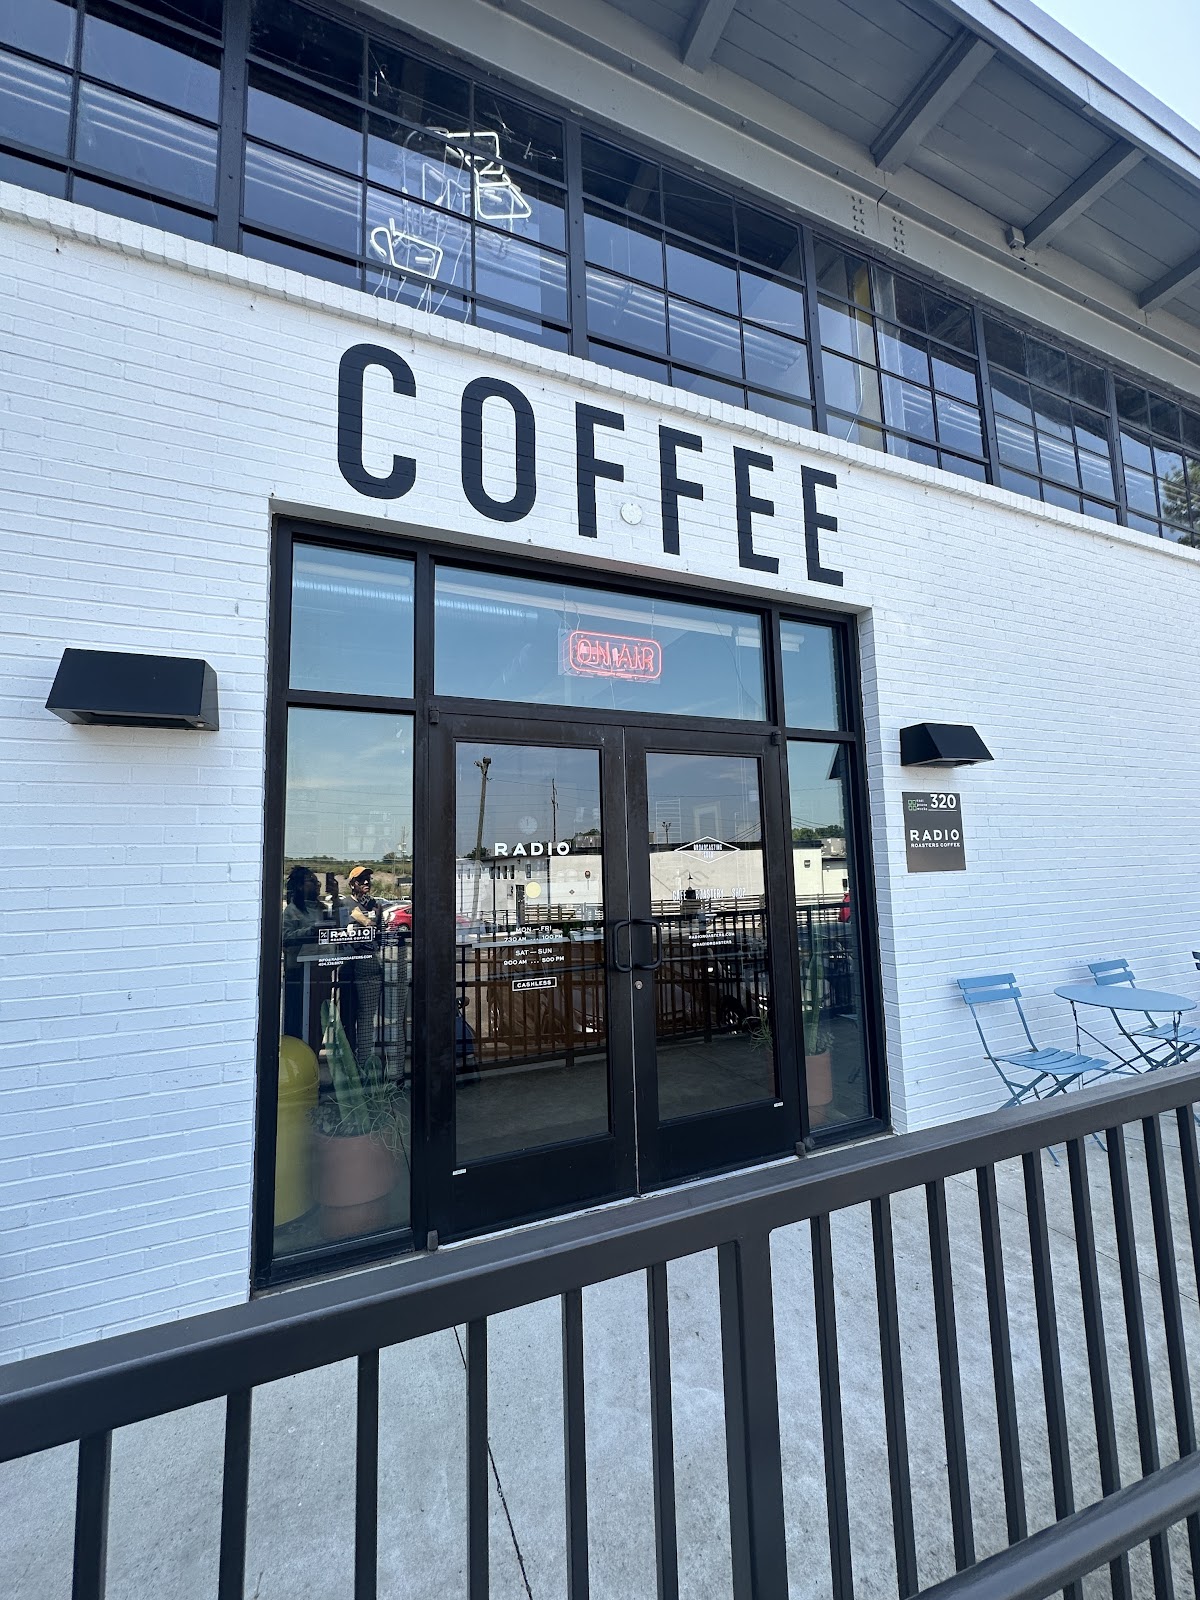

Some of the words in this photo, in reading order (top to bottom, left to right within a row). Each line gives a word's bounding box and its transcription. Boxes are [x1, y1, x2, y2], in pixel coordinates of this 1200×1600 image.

[338, 343, 844, 587] COFFEE
[576, 638, 610, 666] ON
[616, 643, 654, 672] AIR
[930, 794, 956, 809] 320
[909, 829, 960, 841] RADIO
[494, 842, 570, 856] RADIO
[330, 929, 370, 938] RADIO
[540, 924, 552, 932] FRI
[537, 947, 553, 955] SUN
[516, 979, 552, 988] CASHLESS
